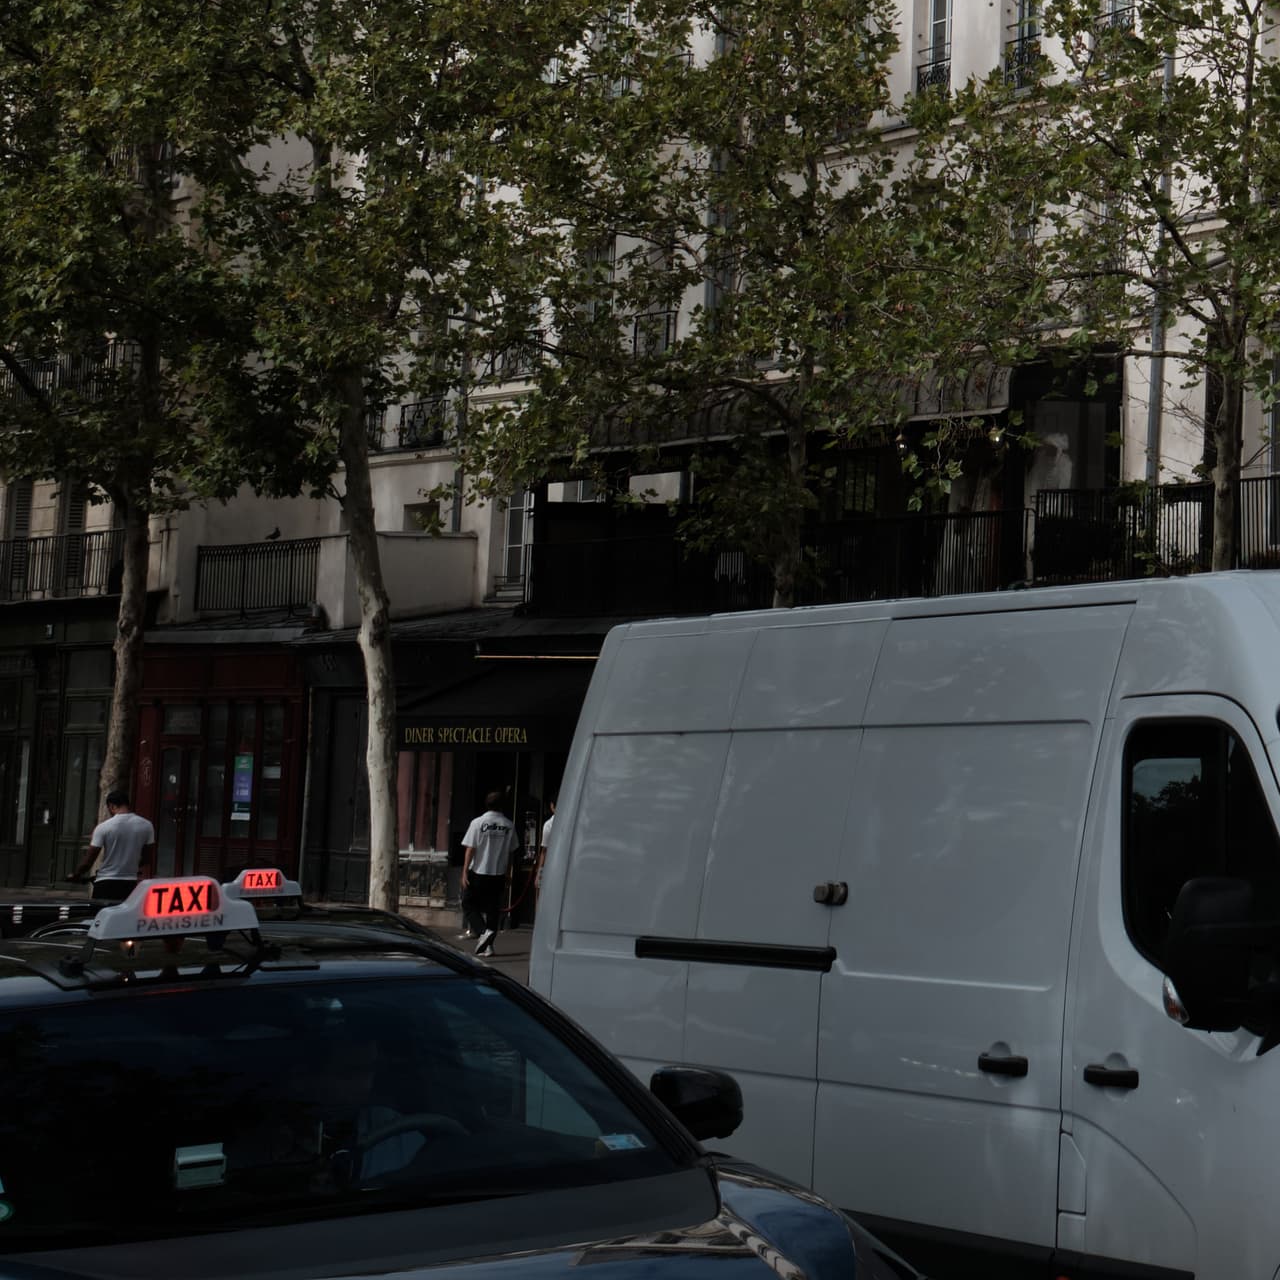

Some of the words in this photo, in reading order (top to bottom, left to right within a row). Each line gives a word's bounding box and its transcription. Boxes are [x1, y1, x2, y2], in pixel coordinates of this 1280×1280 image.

[404, 727, 434, 744] DINER
[437, 727, 493, 744] SPECTACLE
[494, 727, 528, 744] OPERA
[247, 872, 280, 888] TAXI
[152, 884, 213, 914] TAXI
[136, 914, 224, 933] PARISIEN
